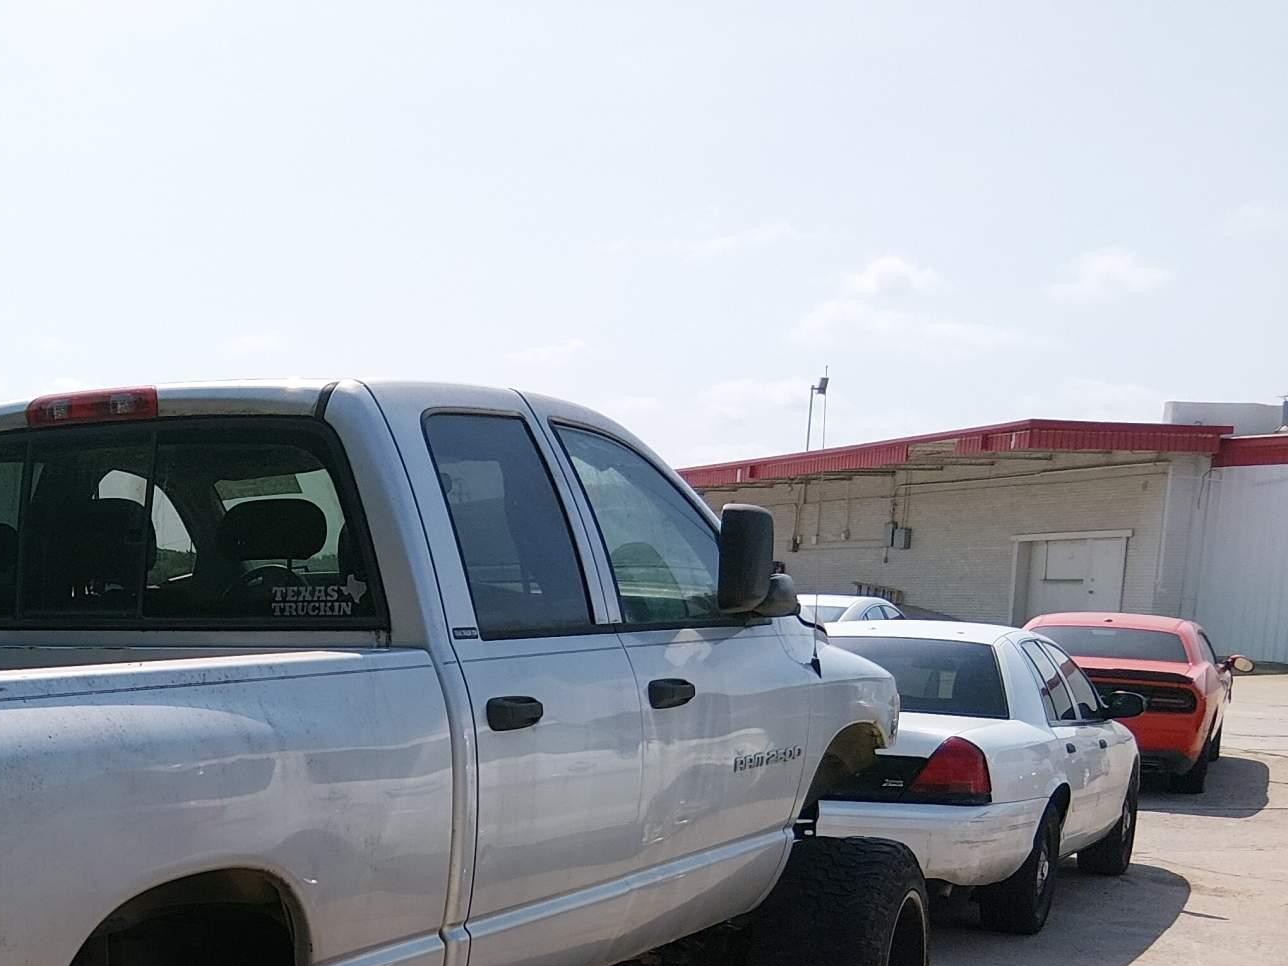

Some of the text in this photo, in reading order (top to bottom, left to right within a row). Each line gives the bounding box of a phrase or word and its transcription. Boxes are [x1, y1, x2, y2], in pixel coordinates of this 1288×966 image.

[272, 586, 338, 601] TEXAS
[271, 602, 352, 616] TRUCKIN
[733, 745, 801, 773] RAM 2500
